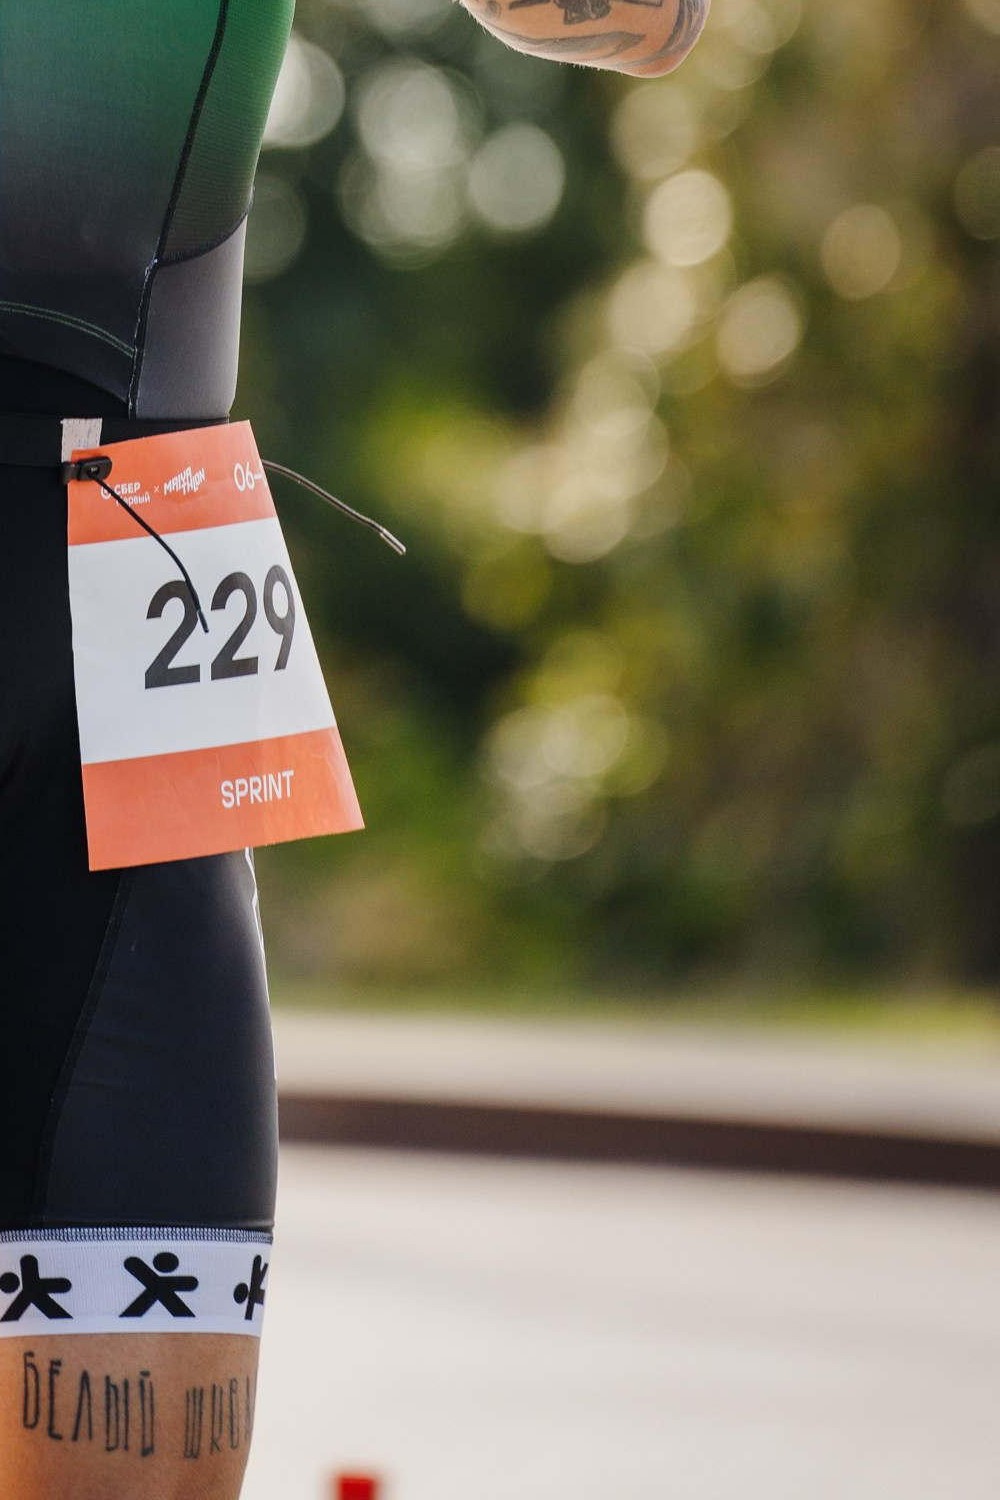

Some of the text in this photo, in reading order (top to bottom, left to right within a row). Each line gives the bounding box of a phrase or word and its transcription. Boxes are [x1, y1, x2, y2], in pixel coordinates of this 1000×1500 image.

[114, 481, 141, 495] СБЕР
[144, 564, 296, 690] 229
[220, 769, 294, 809] SPRINT
